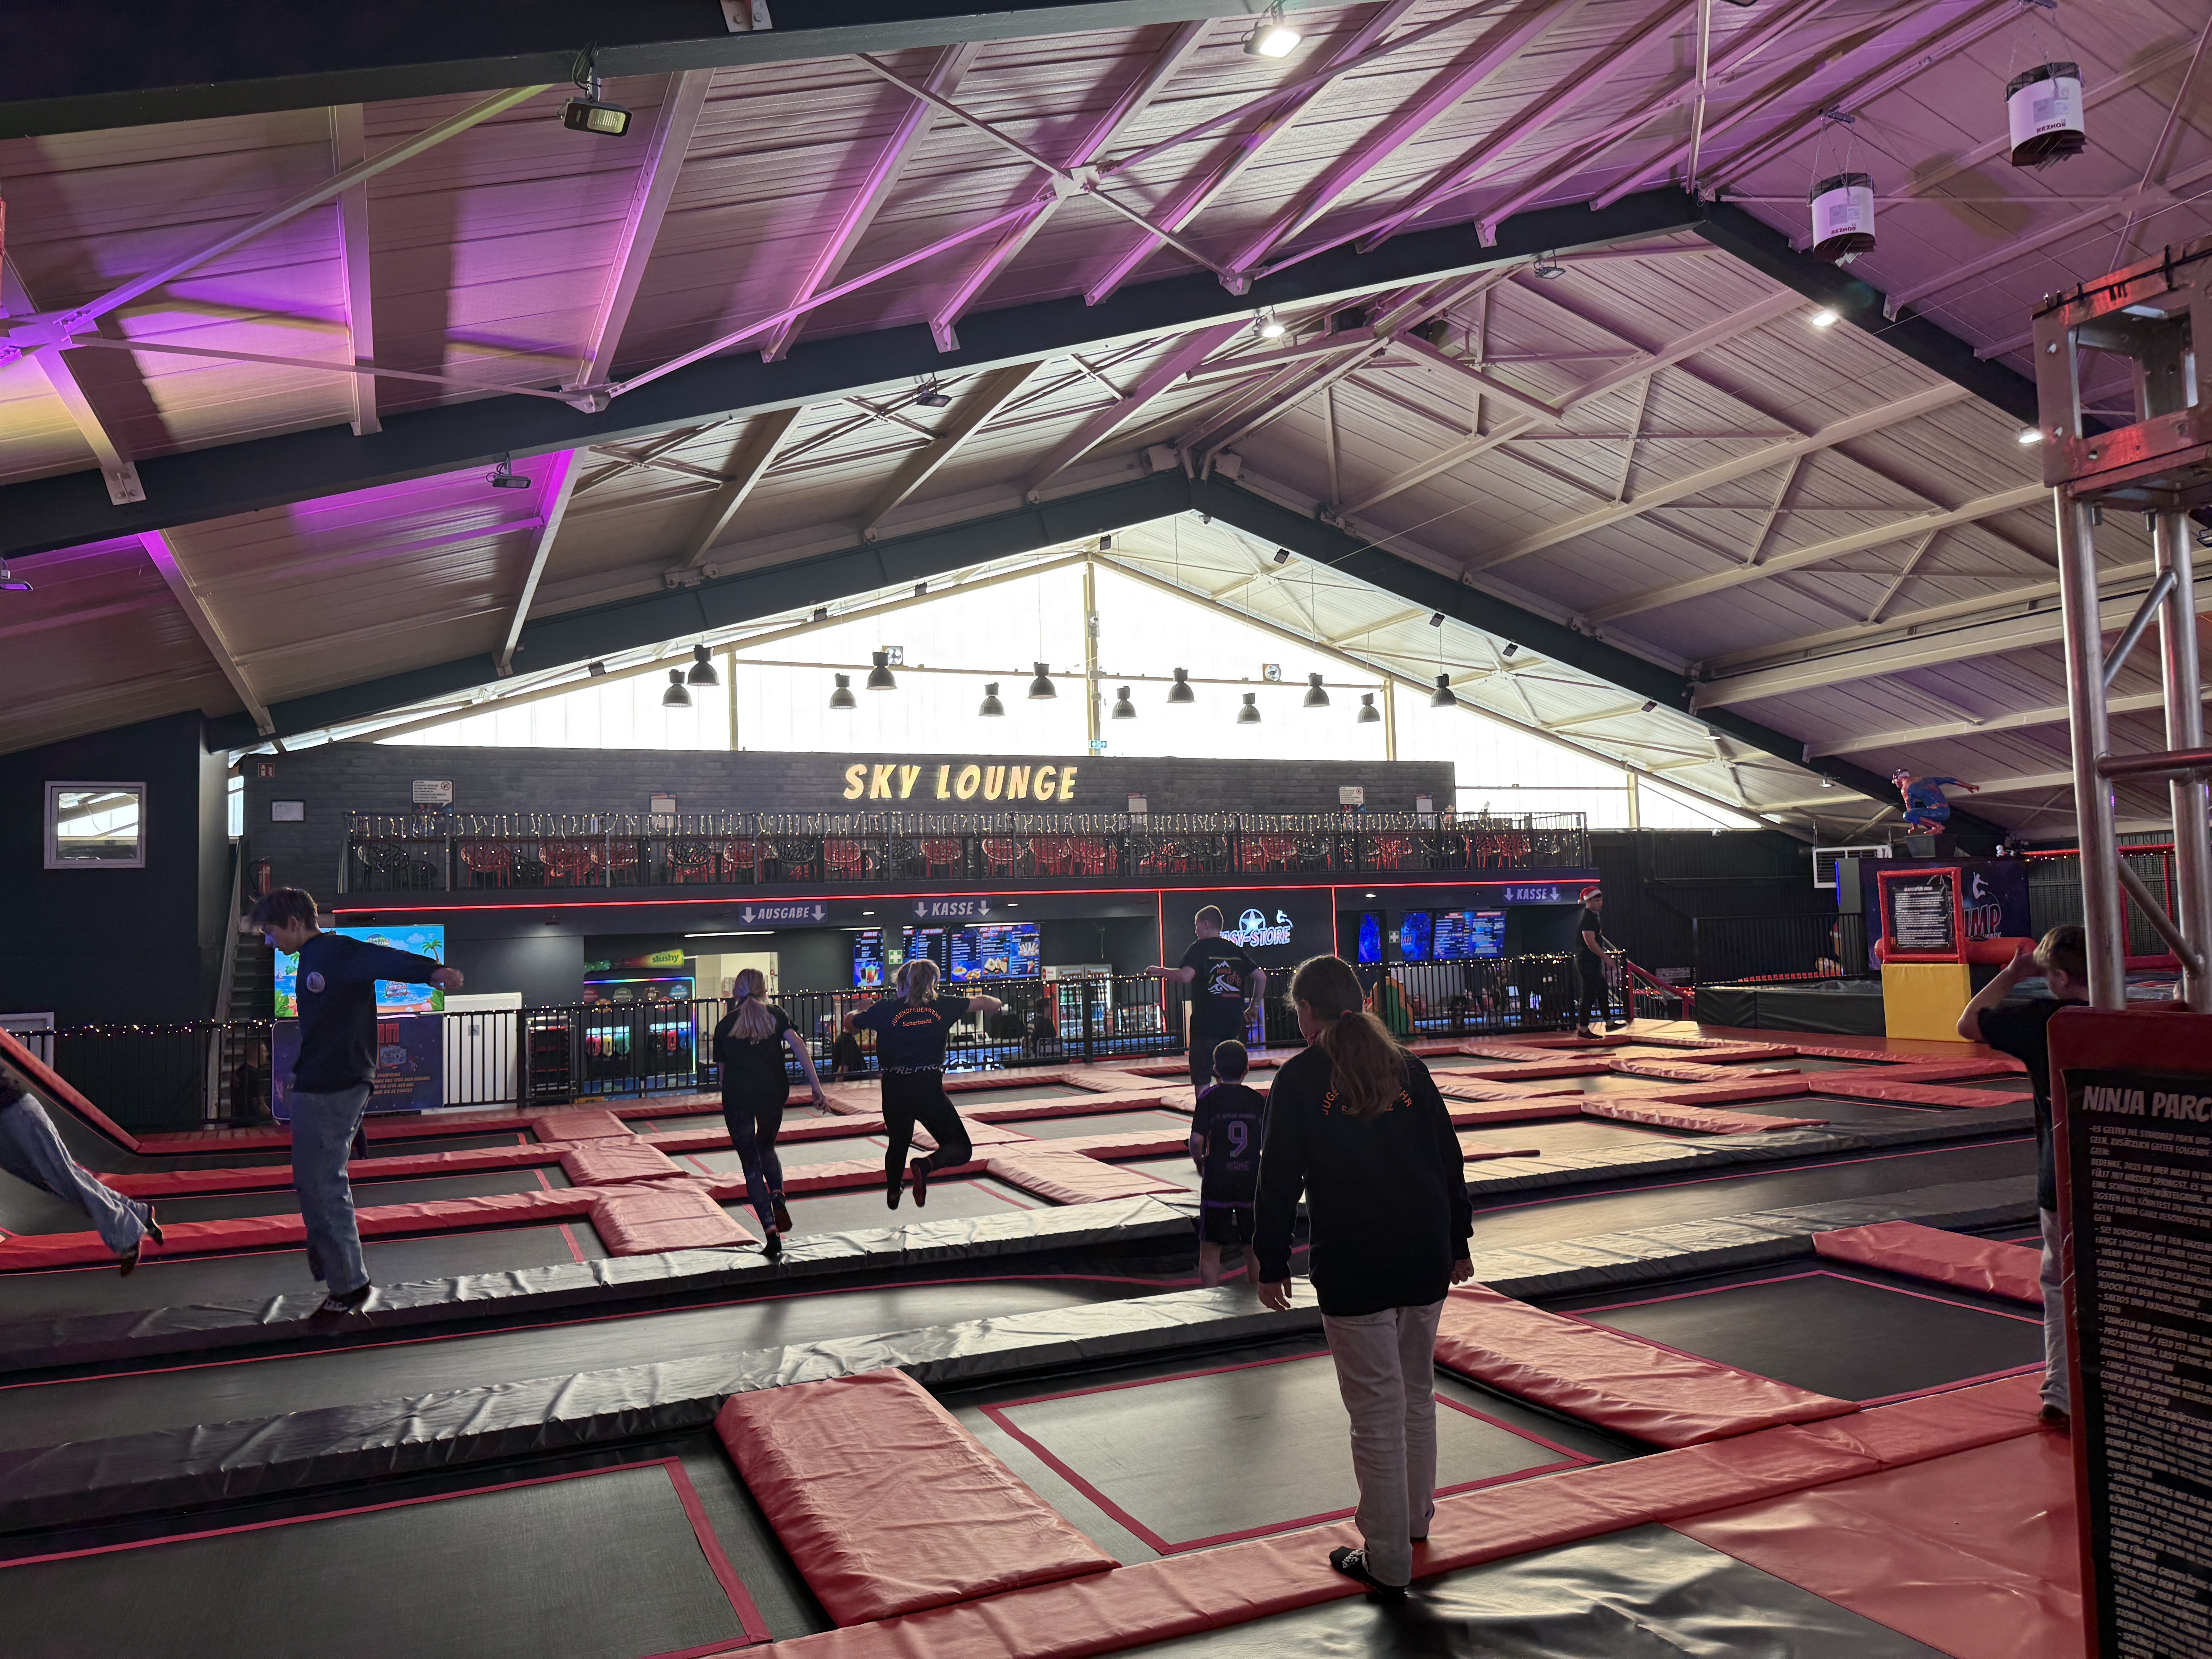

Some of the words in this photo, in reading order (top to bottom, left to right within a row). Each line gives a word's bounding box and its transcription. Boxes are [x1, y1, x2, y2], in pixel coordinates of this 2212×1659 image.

[843, 764, 921, 800] SKY
[936, 764, 1078, 800] LOUNGE
[1516, 888, 1547, 900] KASSE
[757, 907, 810, 919] AUSGABE
[931, 902, 974, 916] KASSE
[1219, 925, 1291, 948] ASY-STORE
[652, 954, 678, 963] slushy
[2082, 1085, 2145, 1115] NINJA
[2151, 1092, 2212, 1122] PARC
[1228, 1121, 1248, 1157] 9
